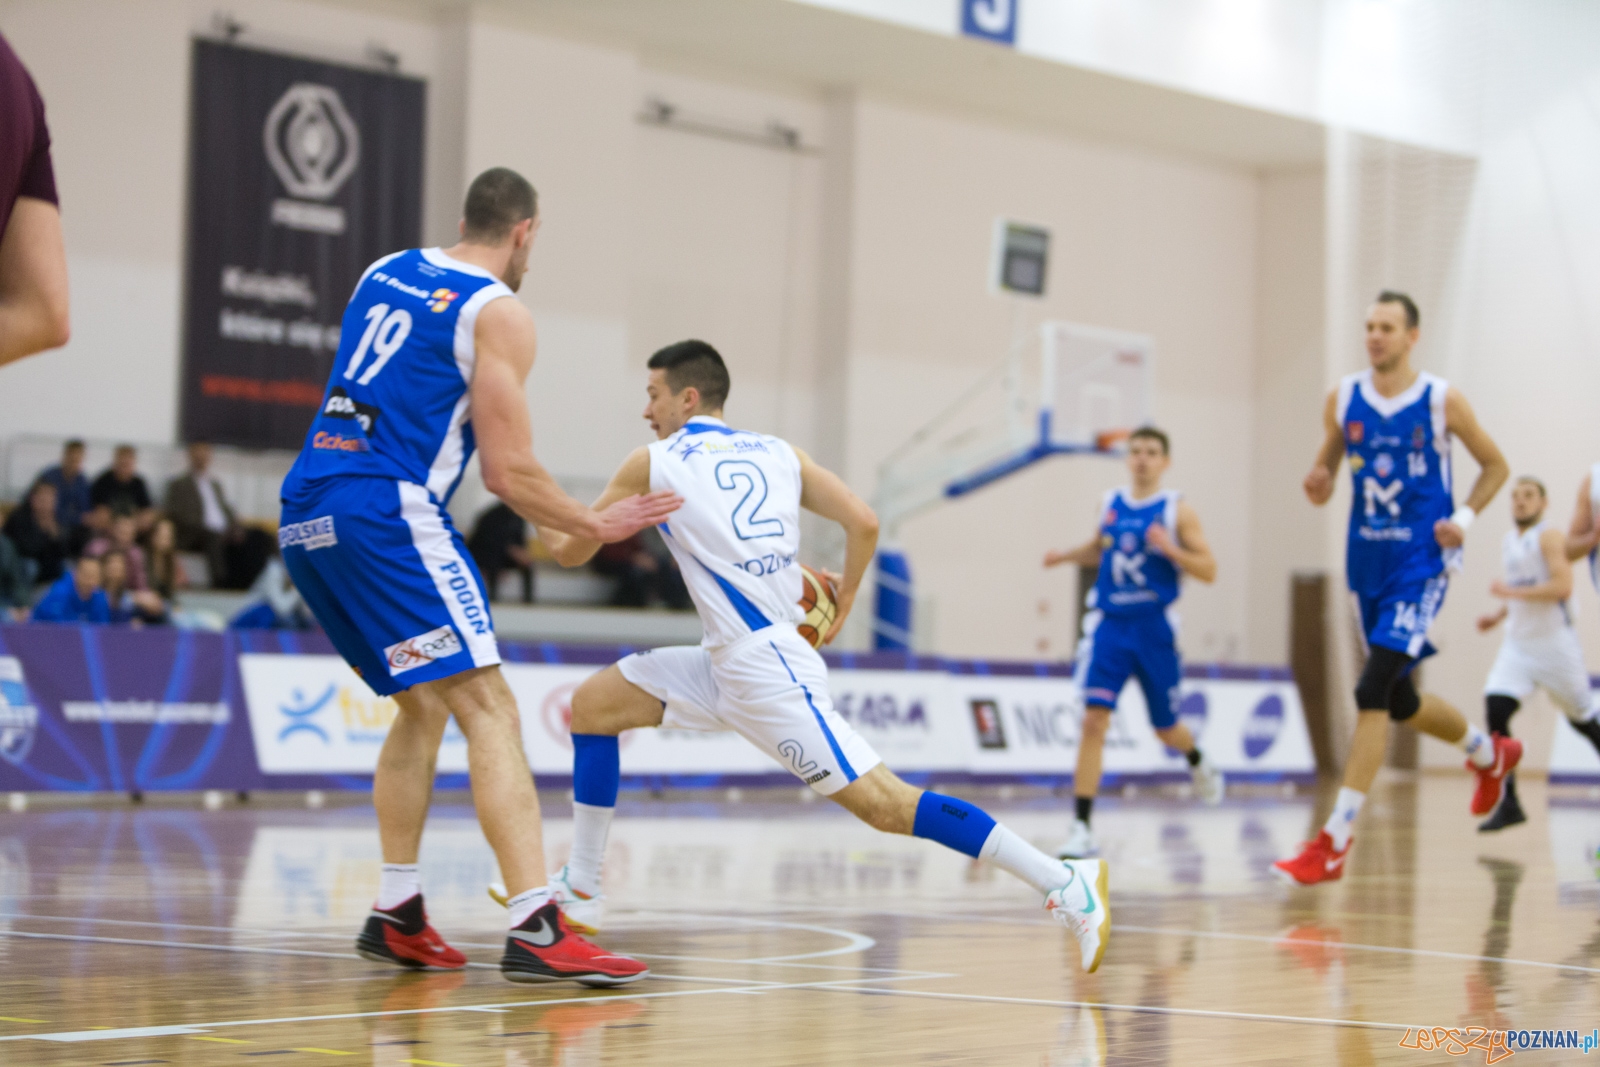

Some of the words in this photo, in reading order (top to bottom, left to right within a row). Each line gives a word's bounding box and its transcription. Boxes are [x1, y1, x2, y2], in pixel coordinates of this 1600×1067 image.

[343, 303, 413, 386] 19
[715, 460, 784, 540] 2
[778, 739, 817, 775] 2
